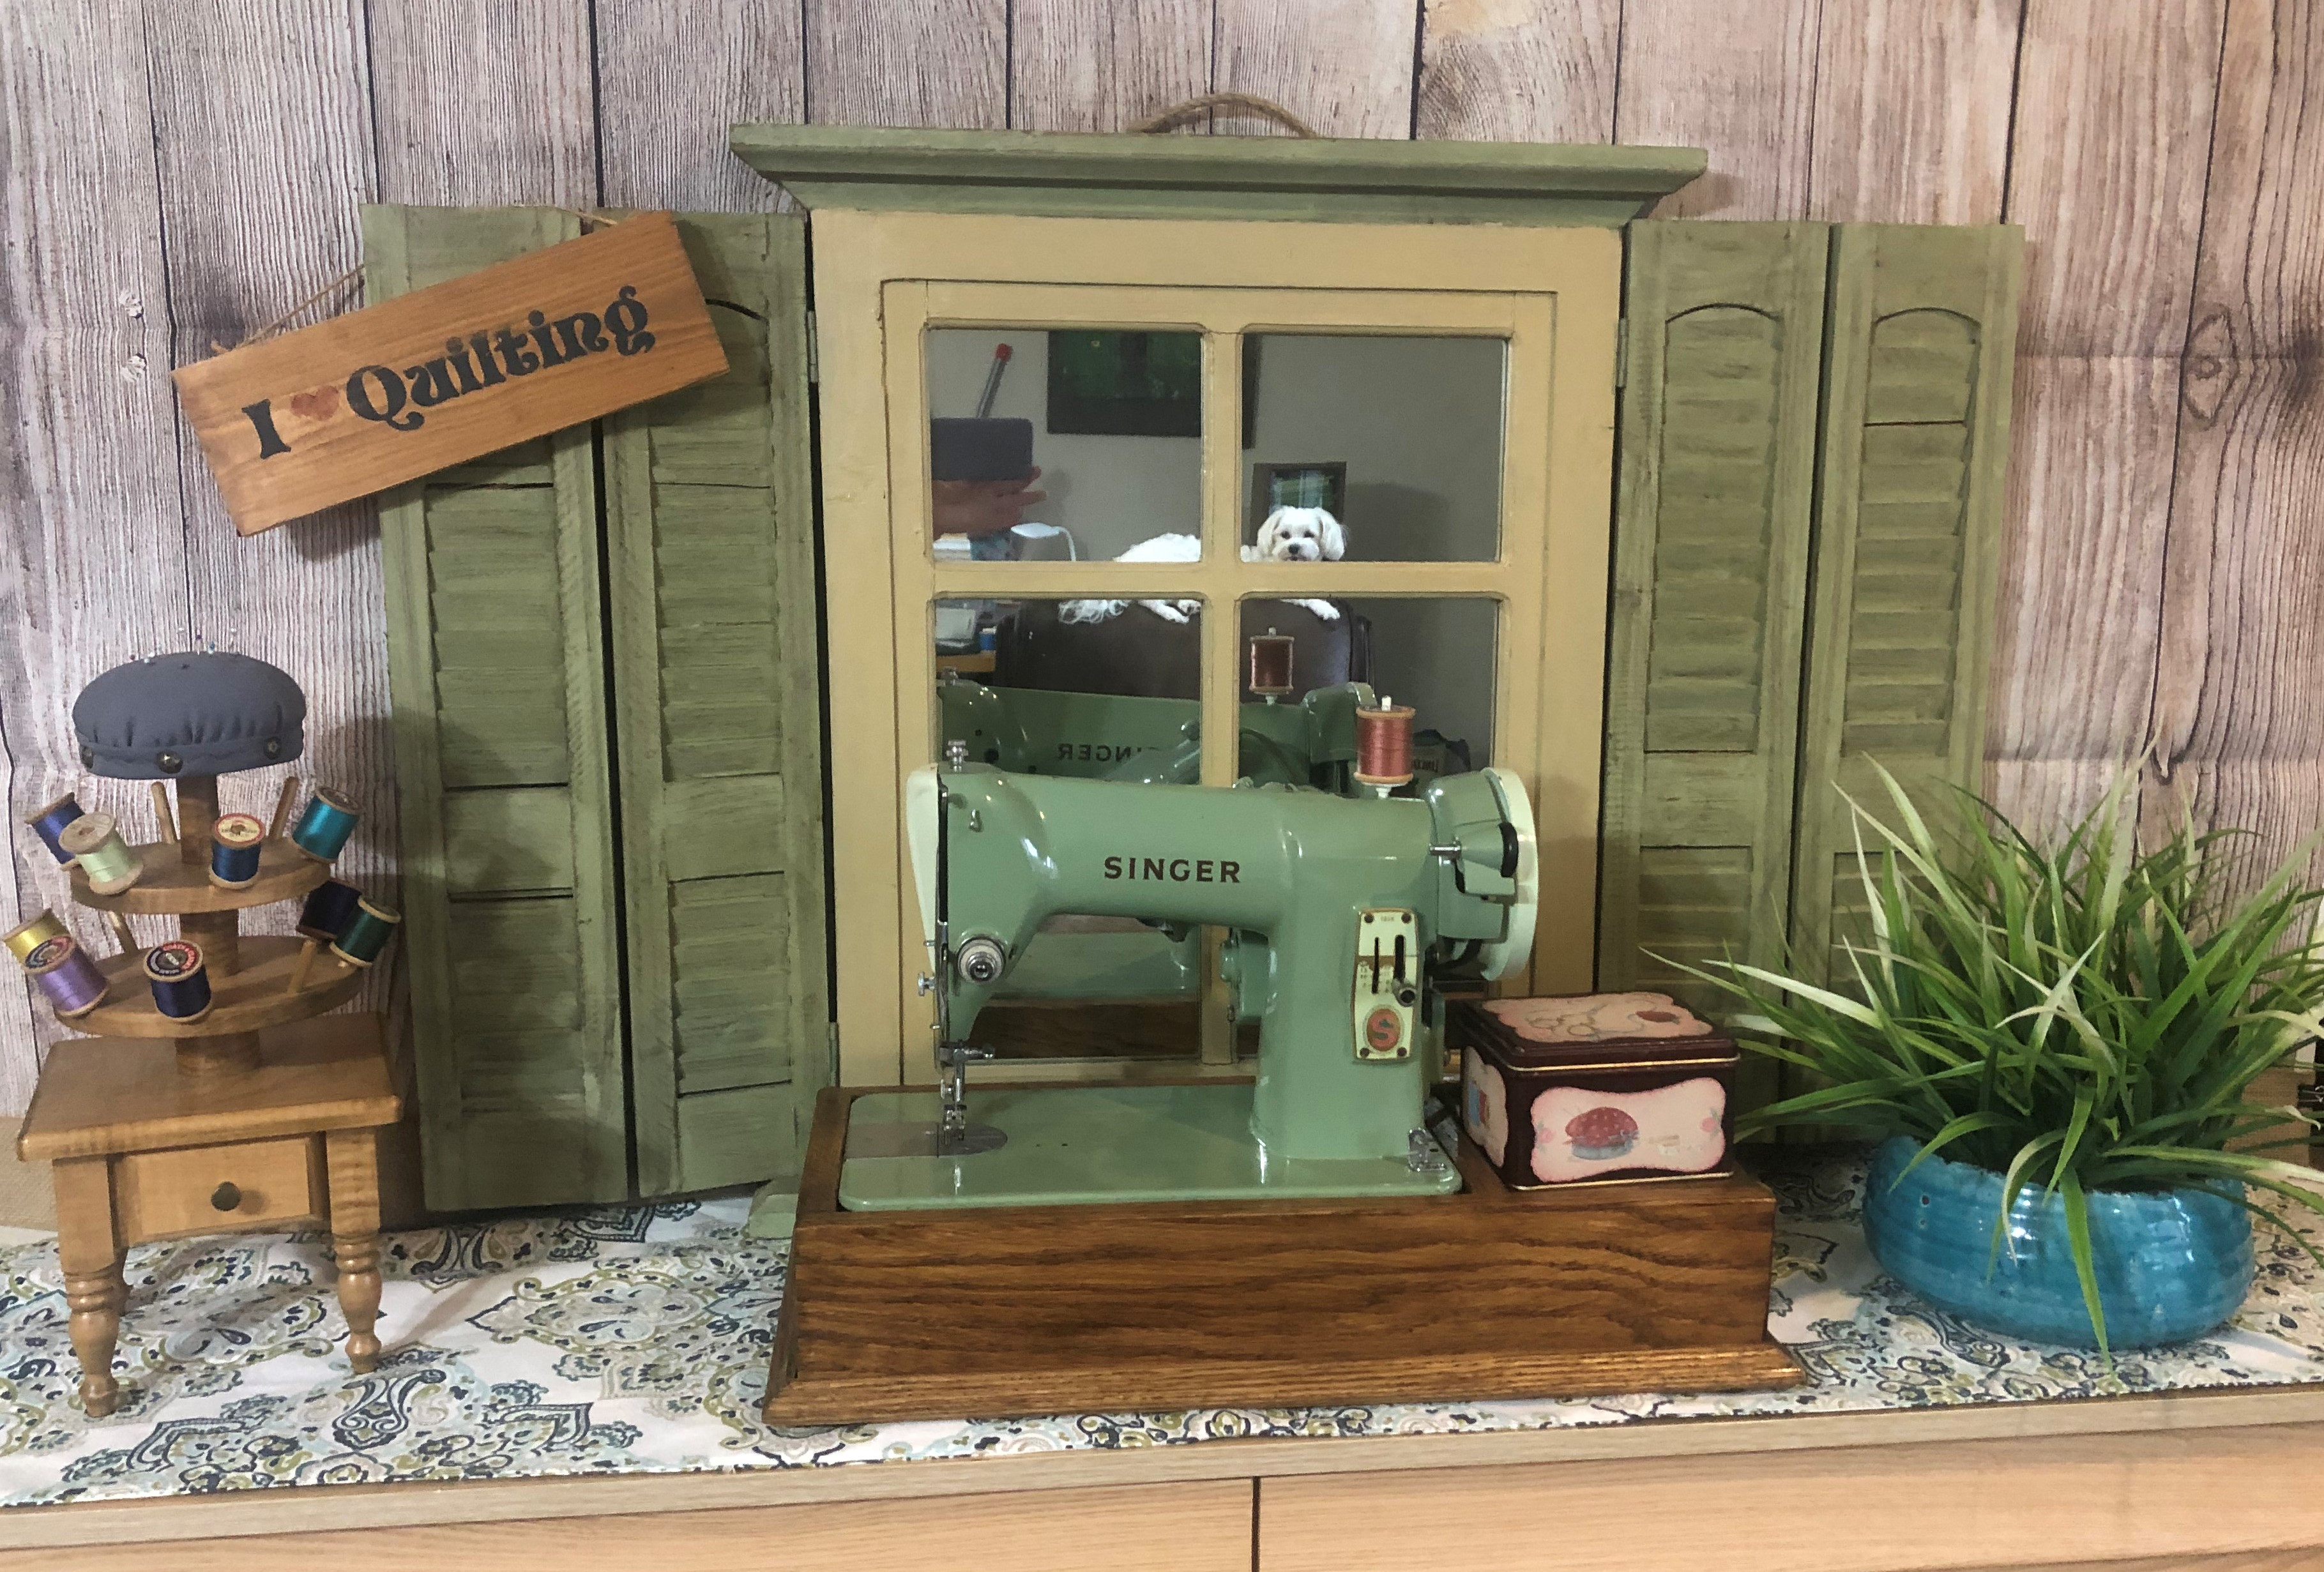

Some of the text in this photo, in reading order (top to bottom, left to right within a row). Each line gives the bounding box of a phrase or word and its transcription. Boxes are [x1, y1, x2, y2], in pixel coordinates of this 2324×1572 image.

[241, 285, 655, 460] I Quilting
[1104, 856, 1240, 883] SINGER
[1369, 1009, 1399, 1050] S
